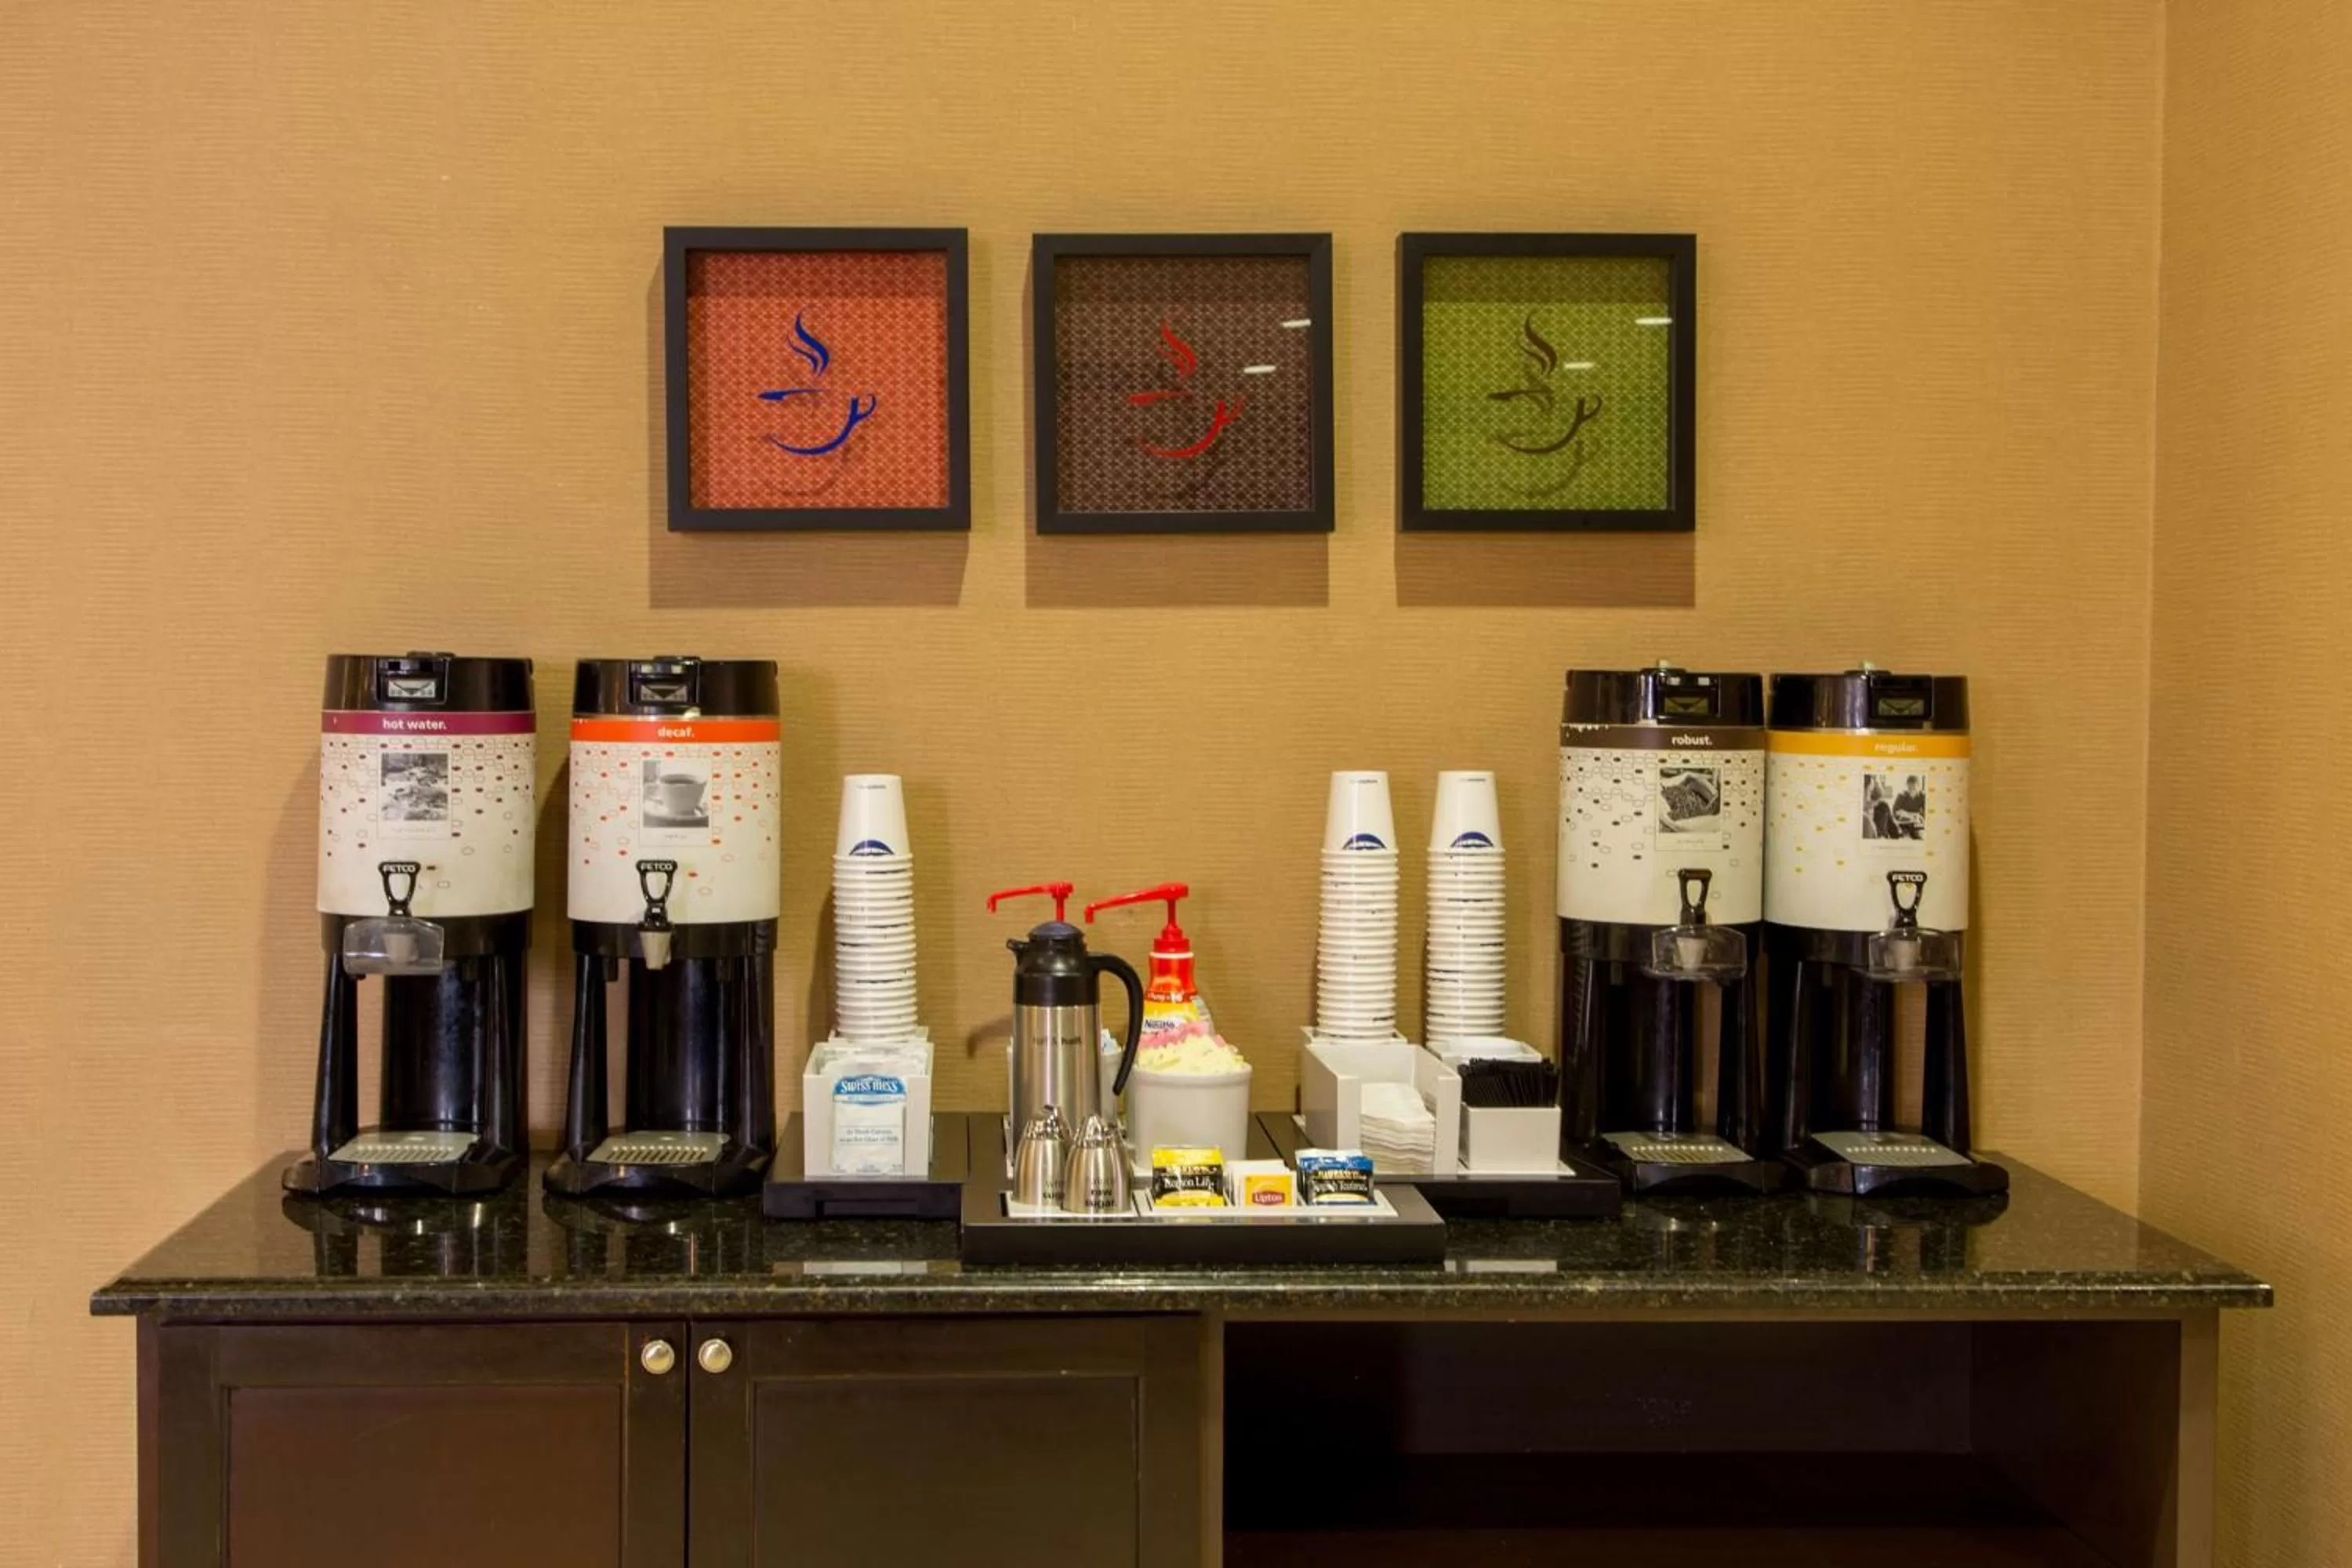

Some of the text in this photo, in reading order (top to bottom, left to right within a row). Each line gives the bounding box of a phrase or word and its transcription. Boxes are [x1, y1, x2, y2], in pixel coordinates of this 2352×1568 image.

[383, 717, 447, 730] hot water.
[657, 726, 695, 739] decaf.
[1671, 733, 1713, 746] robust.
[1875, 741, 1919, 753] regular.
[383, 864, 416, 873] FETCO
[641, 862, 673, 872] FETCO
[1892, 873, 1923, 882] FETCO
[1254, 1192, 1283, 1203] Lipton
